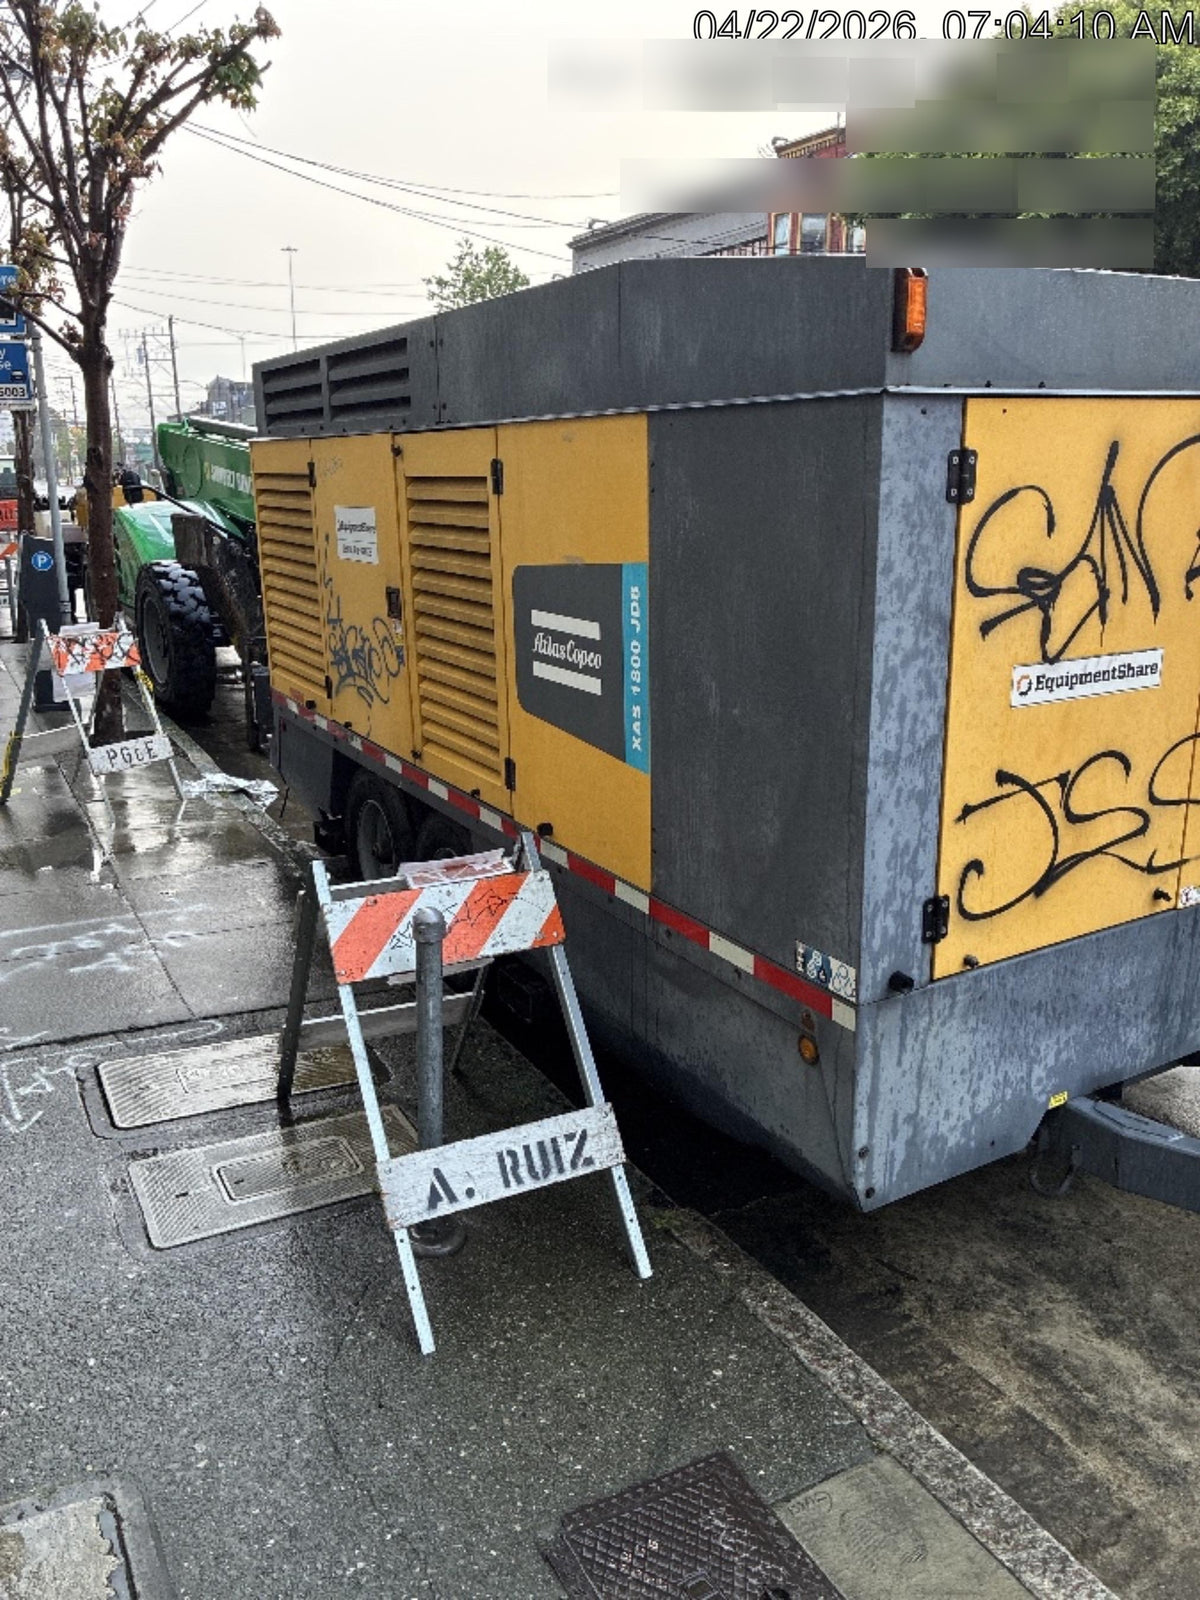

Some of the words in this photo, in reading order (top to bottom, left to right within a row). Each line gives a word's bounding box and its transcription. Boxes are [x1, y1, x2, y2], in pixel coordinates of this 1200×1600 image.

[630, 638, 641, 696] 1800
[1034, 662, 1160, 693] EquipmentShare
[631, 705, 642, 751] XAS
[427, 1167, 476, 1212] A.
[496, 1128, 596, 1189] RUIZ
